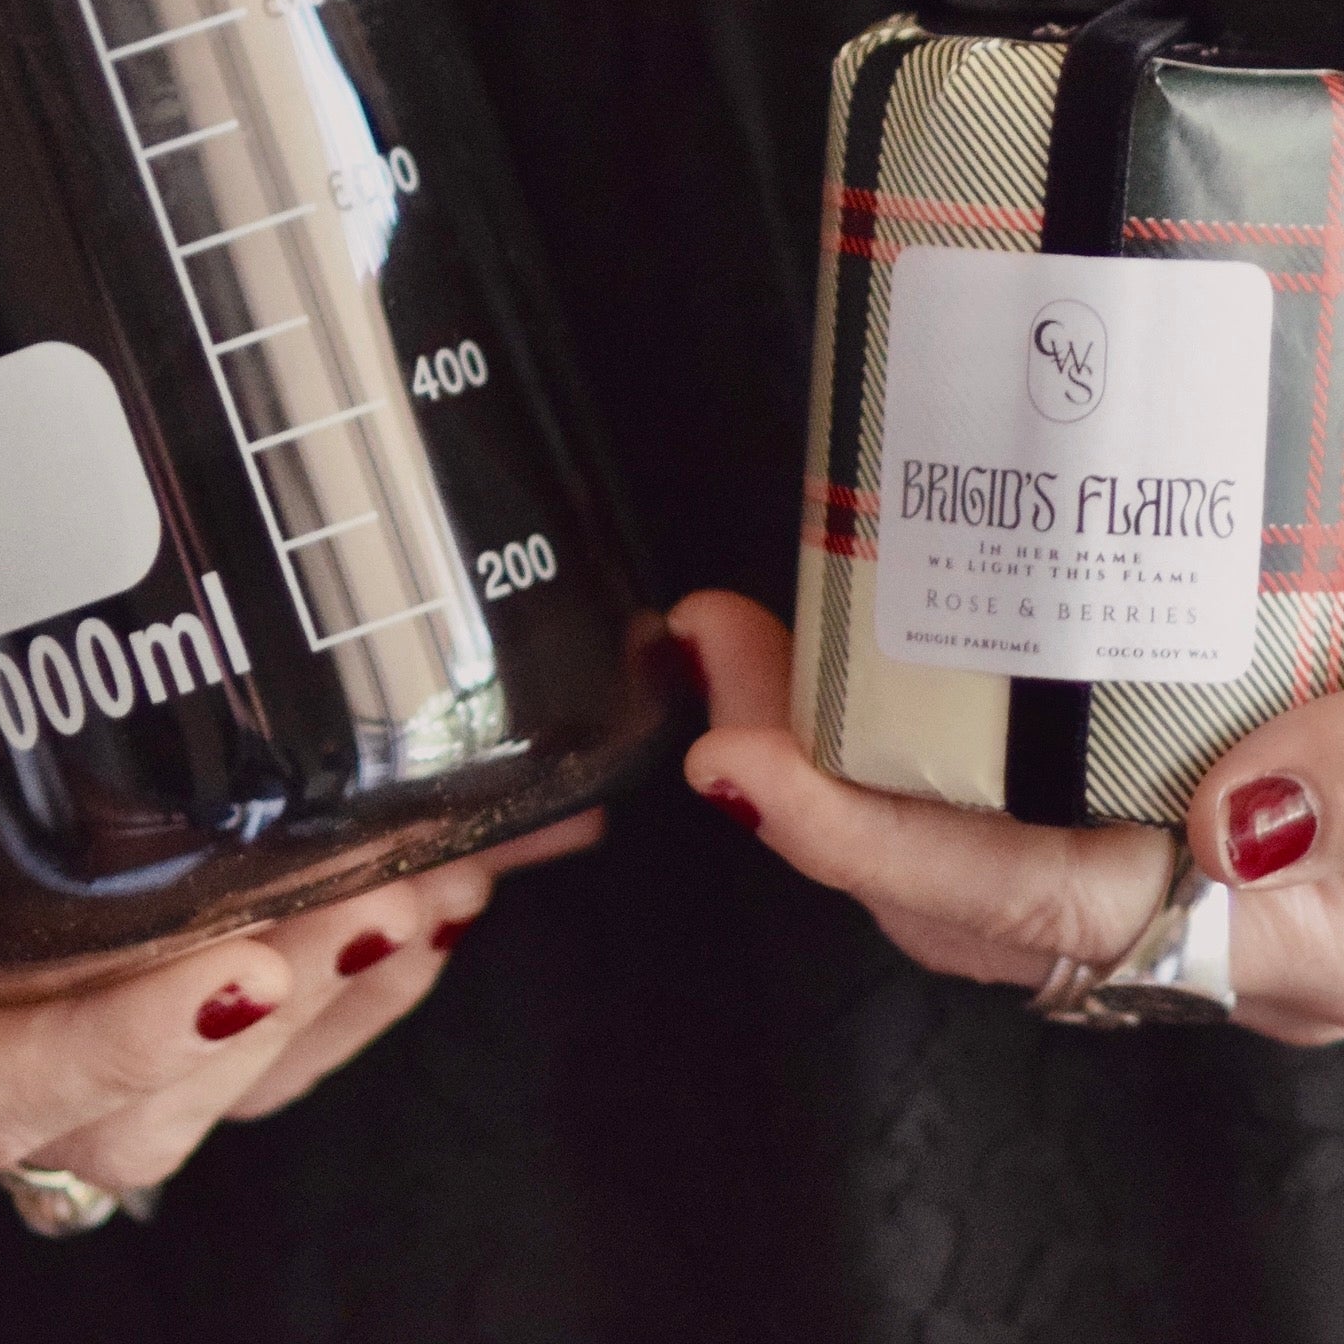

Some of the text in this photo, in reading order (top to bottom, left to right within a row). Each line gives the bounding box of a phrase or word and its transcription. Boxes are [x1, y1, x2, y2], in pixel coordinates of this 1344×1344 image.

[412, 339, 489, 400] 400
[900, 458, 1237, 539] BRIGID'S FLAME
[476, 533, 558, 600] 200
[928, 554, 1200, 584] WE LIGHT THIS FLAME
[979, 540, 1143, 565] IN HER NAME
[926, 588, 1199, 625] ROSE & BERRIES
[905, 630, 1042, 655] BOUGIE PARFUMÉE
[1096, 644, 1146, 659] COCO
[1150, 646, 1179, 660] SOY
